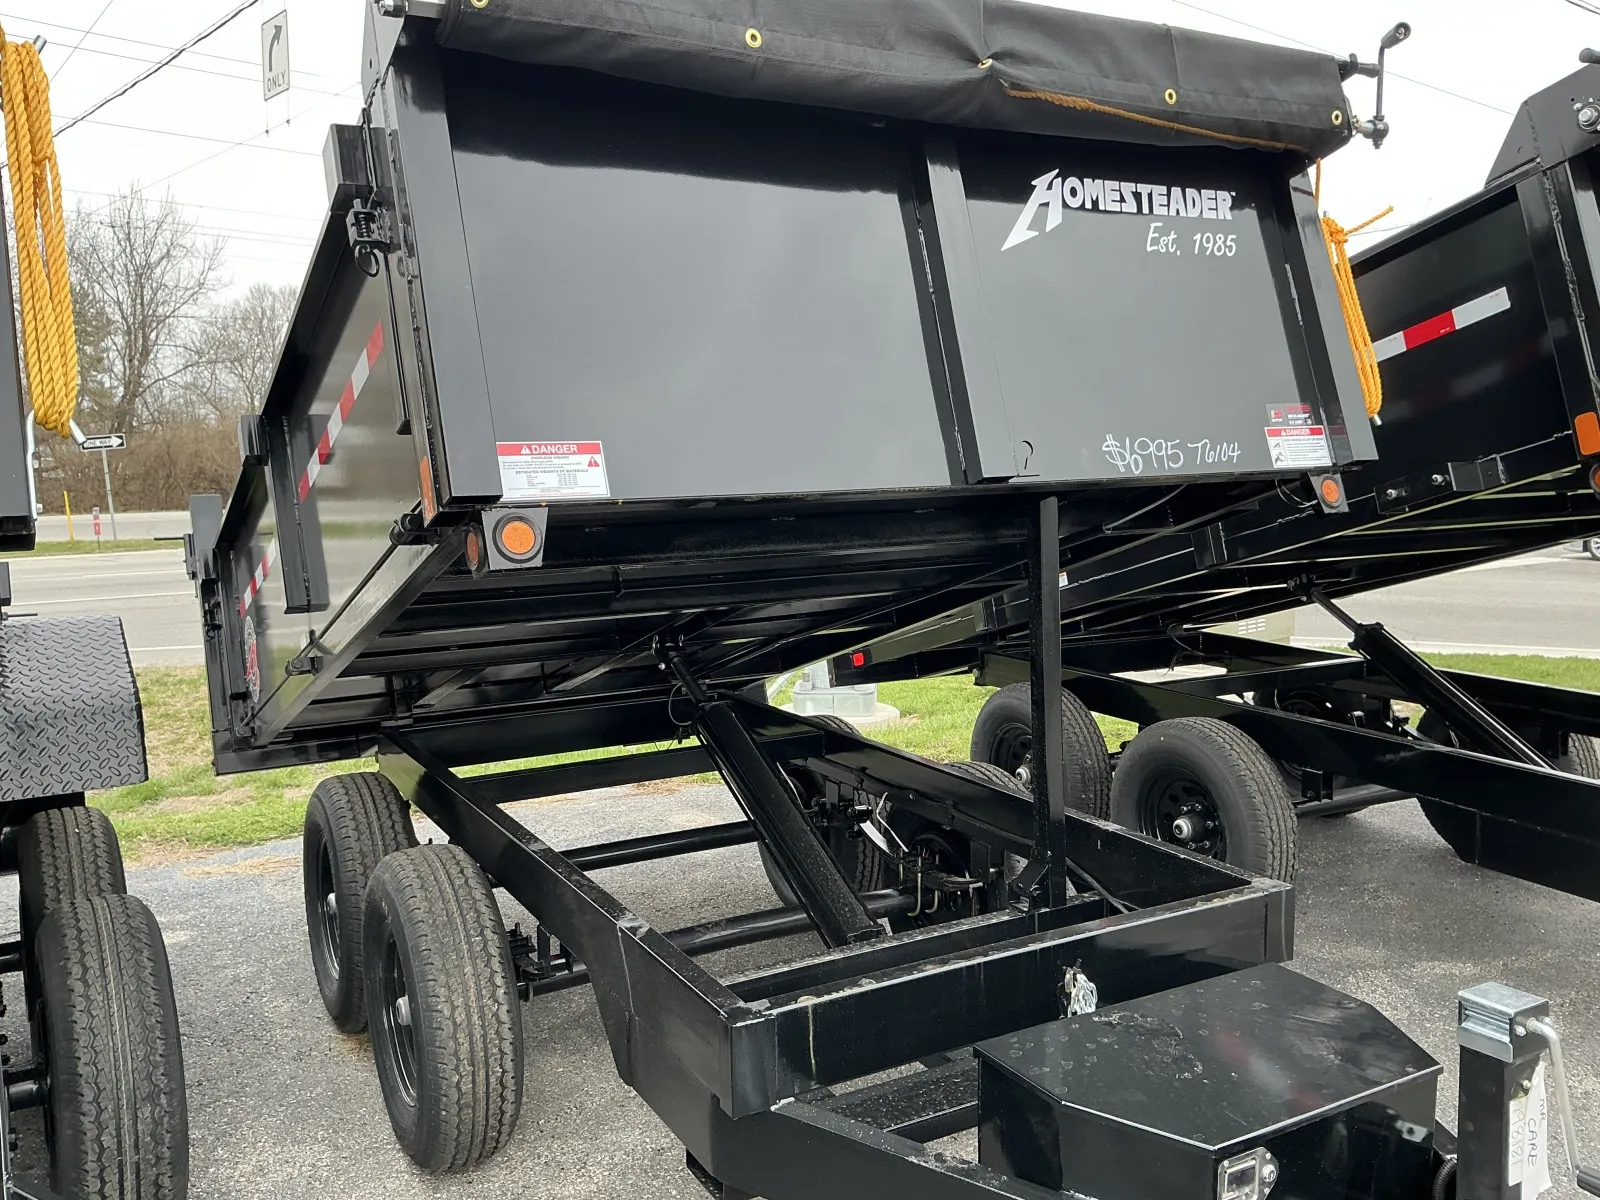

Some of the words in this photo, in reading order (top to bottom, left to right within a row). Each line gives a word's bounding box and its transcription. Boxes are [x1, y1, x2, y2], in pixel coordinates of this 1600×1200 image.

[267, 70, 286, 92] ONLY
[1146, 222, 1181, 256] Est.
[1193, 232, 1237, 257] 1985
[531, 445, 578, 454] DANGER
[1102, 433, 1184, 475] $6995
[1187, 438, 1241, 465] T6104
[1527, 1118, 1538, 1168] CARE
